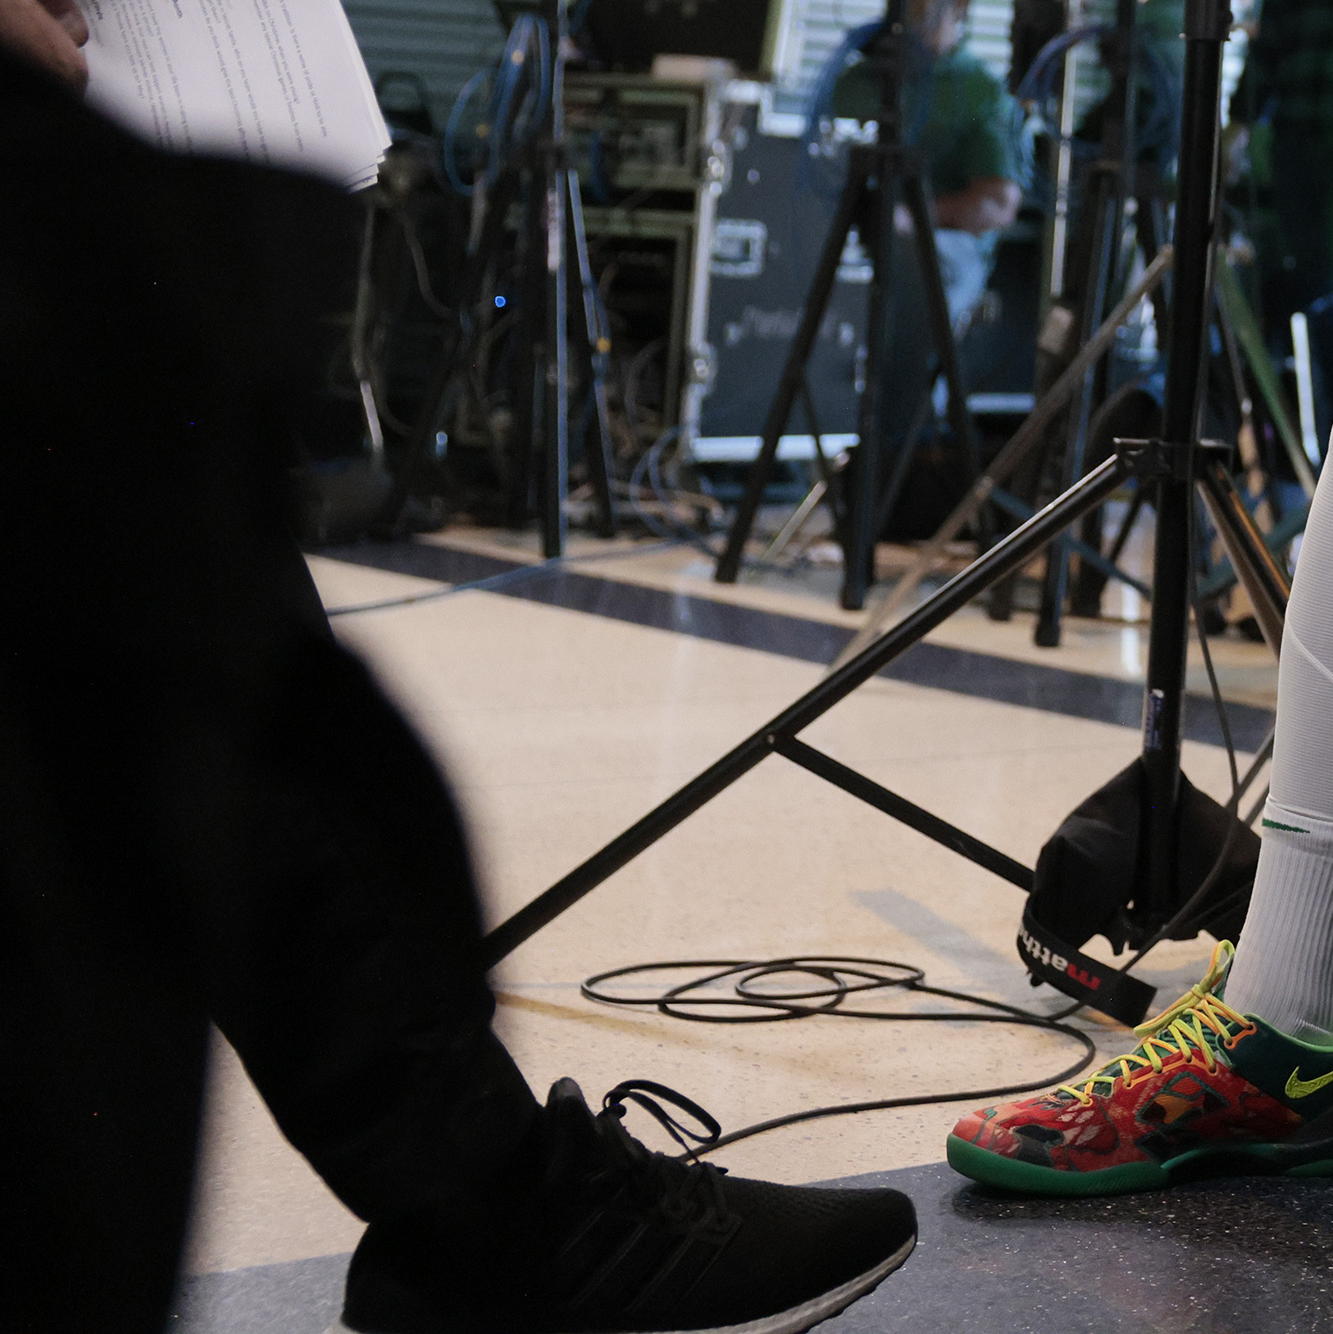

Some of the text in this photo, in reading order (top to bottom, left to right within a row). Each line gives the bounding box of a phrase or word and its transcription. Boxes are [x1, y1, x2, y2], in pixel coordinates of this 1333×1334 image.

[267, 17, 281, 45] Christmas
[259, 20, 267, 32] any
[263, 31, 274, 51] special
[270, 49, 282, 77] Christmas
[277, 76, 287, 95] games
[277, 44, 286, 60] when
[281, 59, 289, 71] you
[285, 70, 293, 85] were
[304, 74, 313, 91] pride
